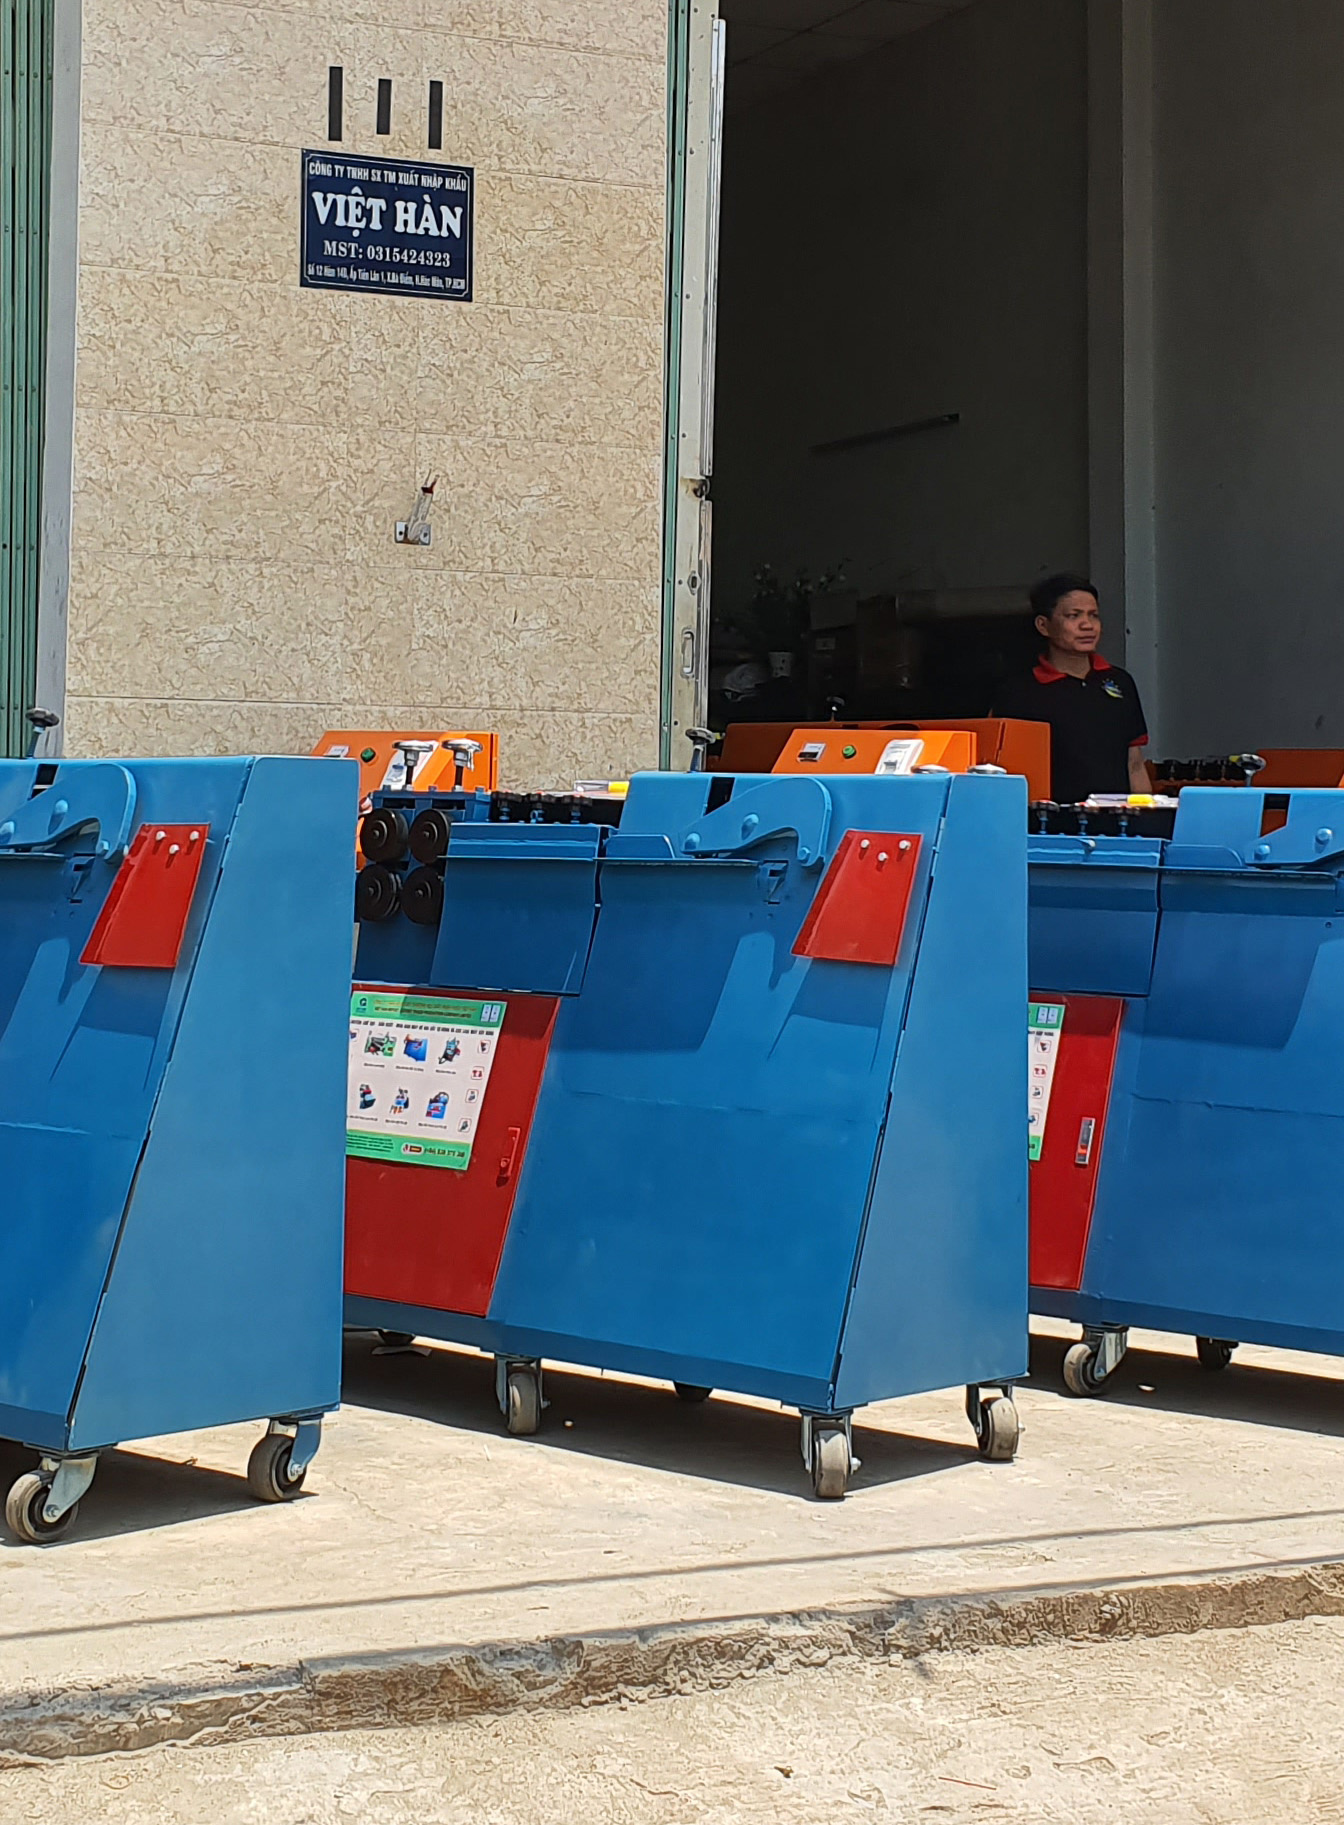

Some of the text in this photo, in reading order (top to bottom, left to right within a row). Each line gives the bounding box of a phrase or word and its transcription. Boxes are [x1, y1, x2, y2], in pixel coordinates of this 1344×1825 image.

[309, 160, 333, 176] CÔNG
[334, 165, 345, 178] TY
[346, 166, 369, 180] TNHH
[370, 168, 382, 182] SX
[383, 170, 397, 184] TM
[398, 170, 420, 187] XUẤT
[311, 186, 463, 239] VIỆT HÀN
[323, 240, 451, 268] MST: 0315424323
